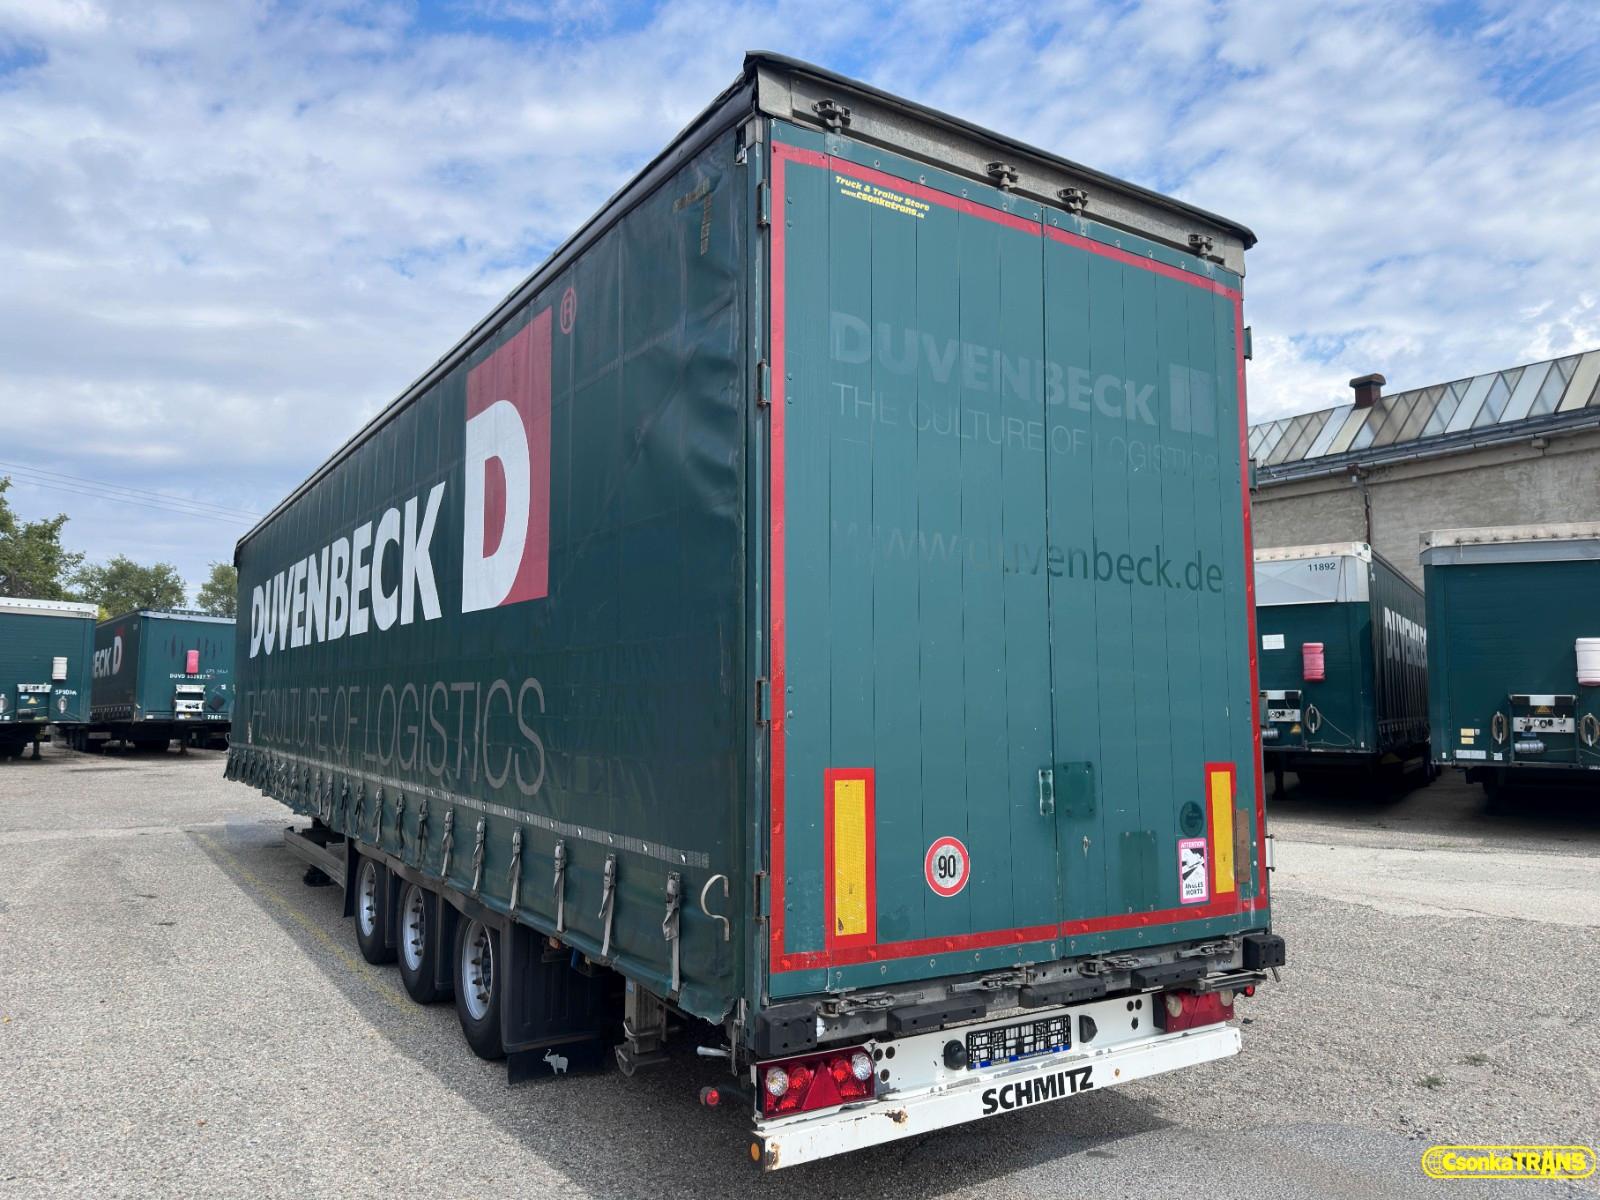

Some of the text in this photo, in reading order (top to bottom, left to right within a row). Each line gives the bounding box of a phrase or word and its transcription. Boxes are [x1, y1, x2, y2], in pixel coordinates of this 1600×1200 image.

[835, 175, 930, 211] Truck & Trailer Store
[830, 311, 1157, 425] DUVENBECK
[831, 382, 898, 425] THE
[908, 398, 1043, 453] CULTURE
[1051, 424, 1087, 457] OF
[462, 400, 531, 613] D
[249, 481, 446, 659] DUVENBECK
[1307, 562, 1336, 572] 11892
[93, 646, 112, 680] ECK
[333, 684, 361, 760] OF
[363, 677, 546, 796] LOGISTICS
[938, 855, 956, 879] 90
[982, 1065, 1094, 1115] SCHMITZ
